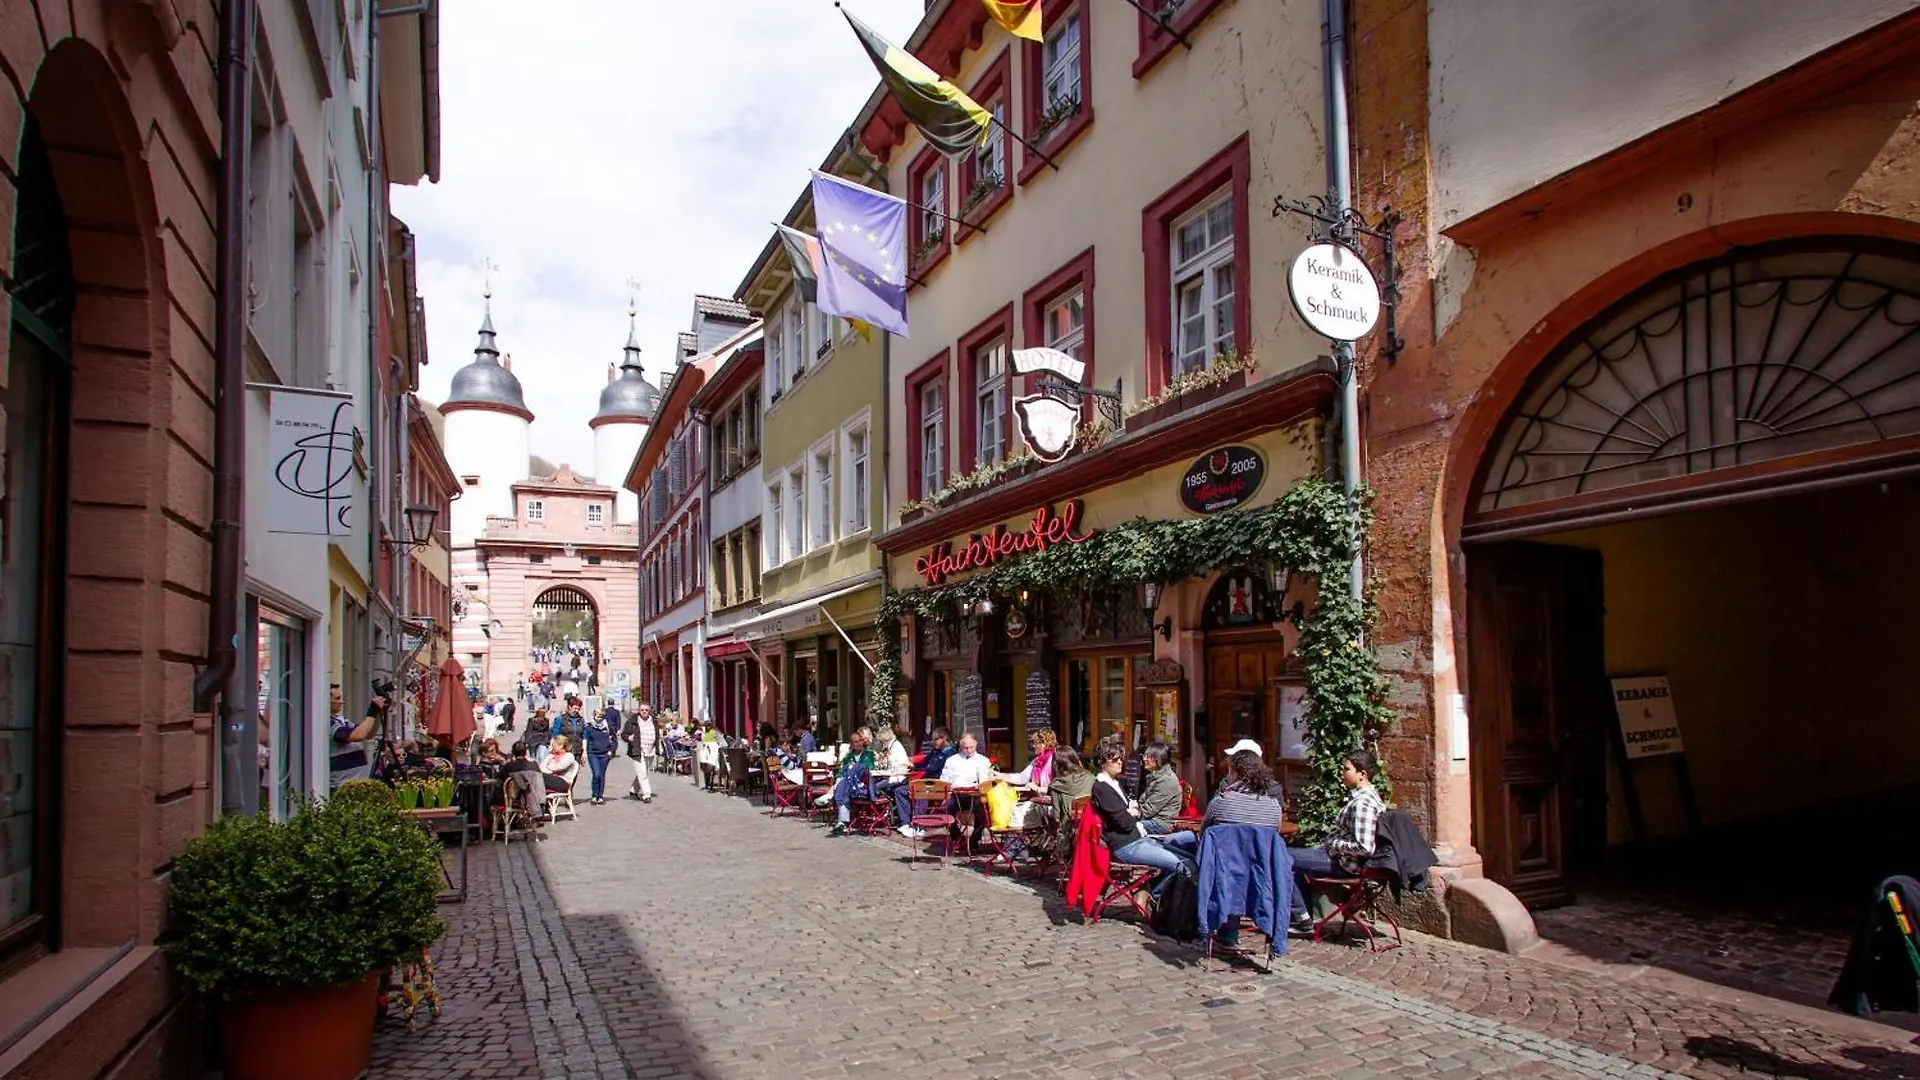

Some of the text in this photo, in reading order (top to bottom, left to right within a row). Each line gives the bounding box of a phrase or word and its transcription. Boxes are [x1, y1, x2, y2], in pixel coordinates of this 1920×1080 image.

[1677, 192, 1692, 213] 9
[1306, 258, 1364, 285] Keramik
[1330, 283, 1343, 300] &
[1306, 296, 1369, 324] Schmuck
[1016, 350, 1079, 380] HOTEL
[1184, 457, 1257, 488] 1955 2005
[1617, 687, 1669, 701] KERAMIK
[1626, 727, 1679, 744] SCHMUCK
